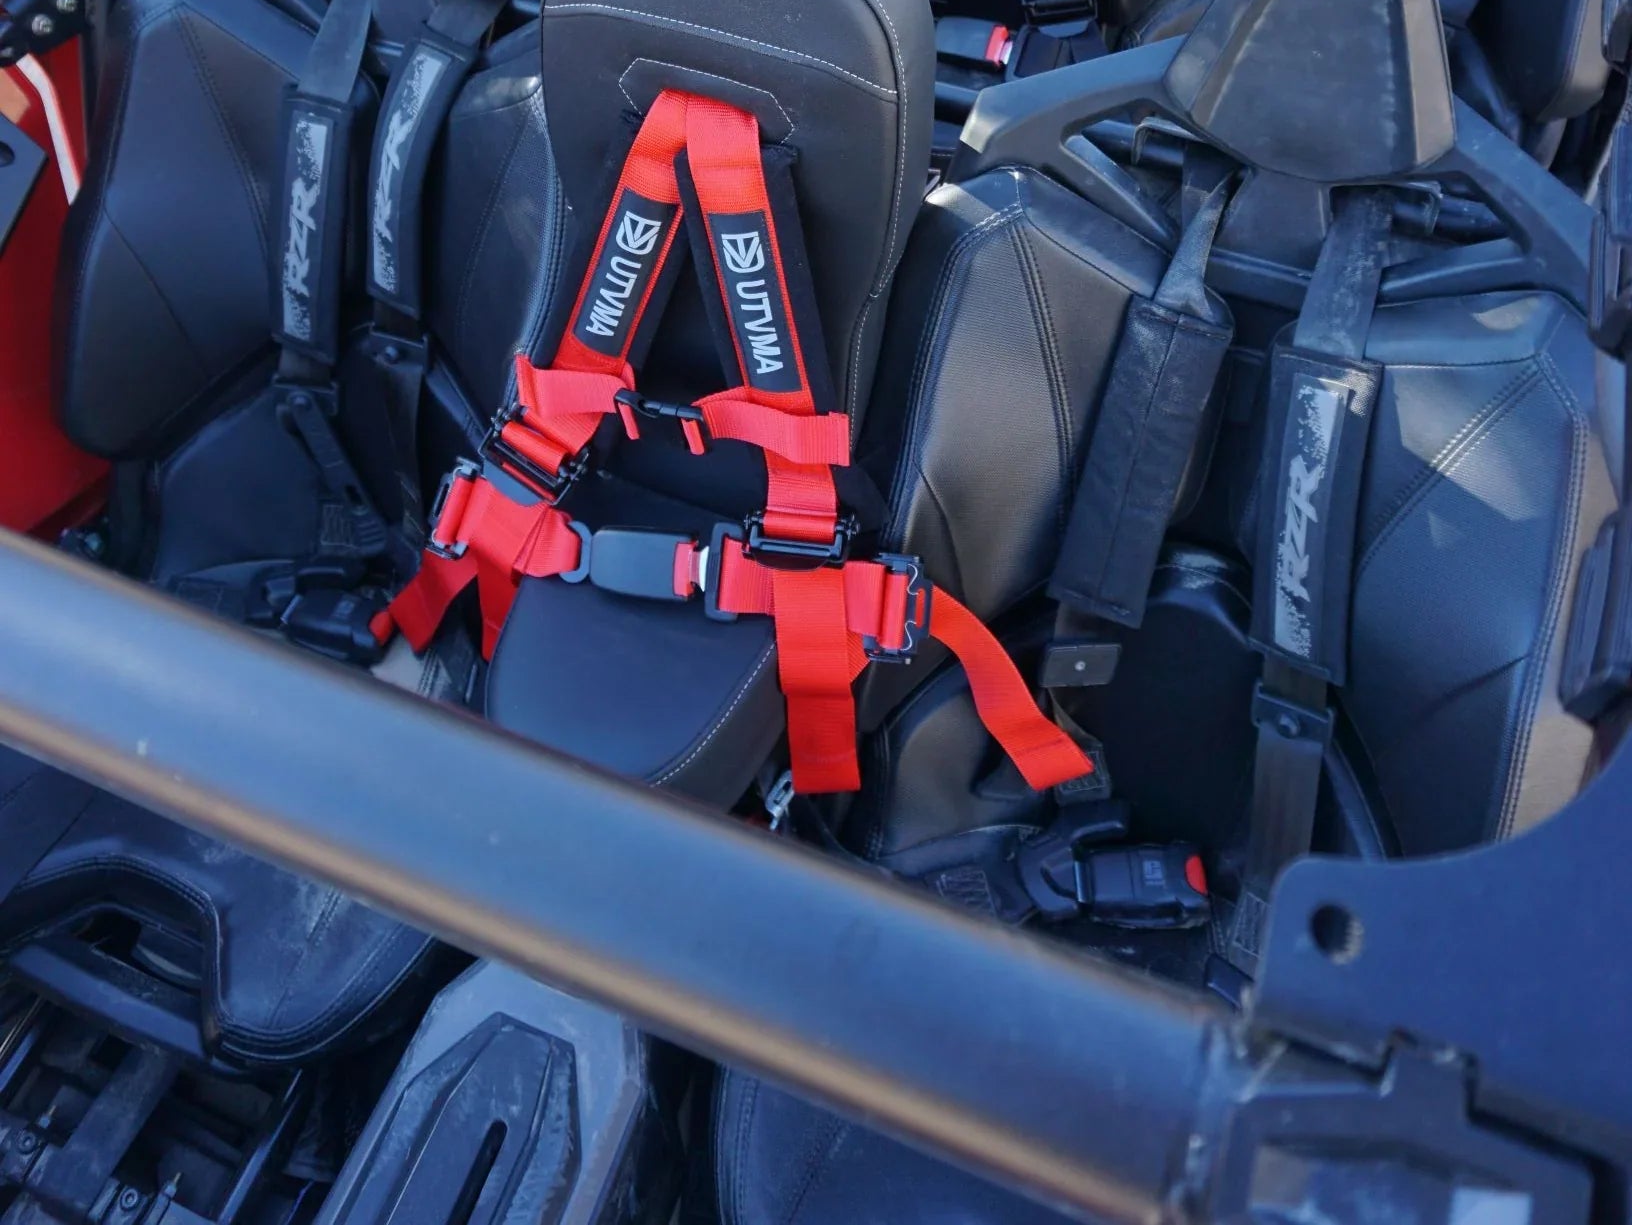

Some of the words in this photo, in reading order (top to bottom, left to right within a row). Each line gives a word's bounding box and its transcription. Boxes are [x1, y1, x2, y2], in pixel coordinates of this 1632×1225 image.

[585, 255, 642, 337] UTVMA
[735, 279, 784, 374] UTVMA
[1277, 455, 1324, 603] RZR
